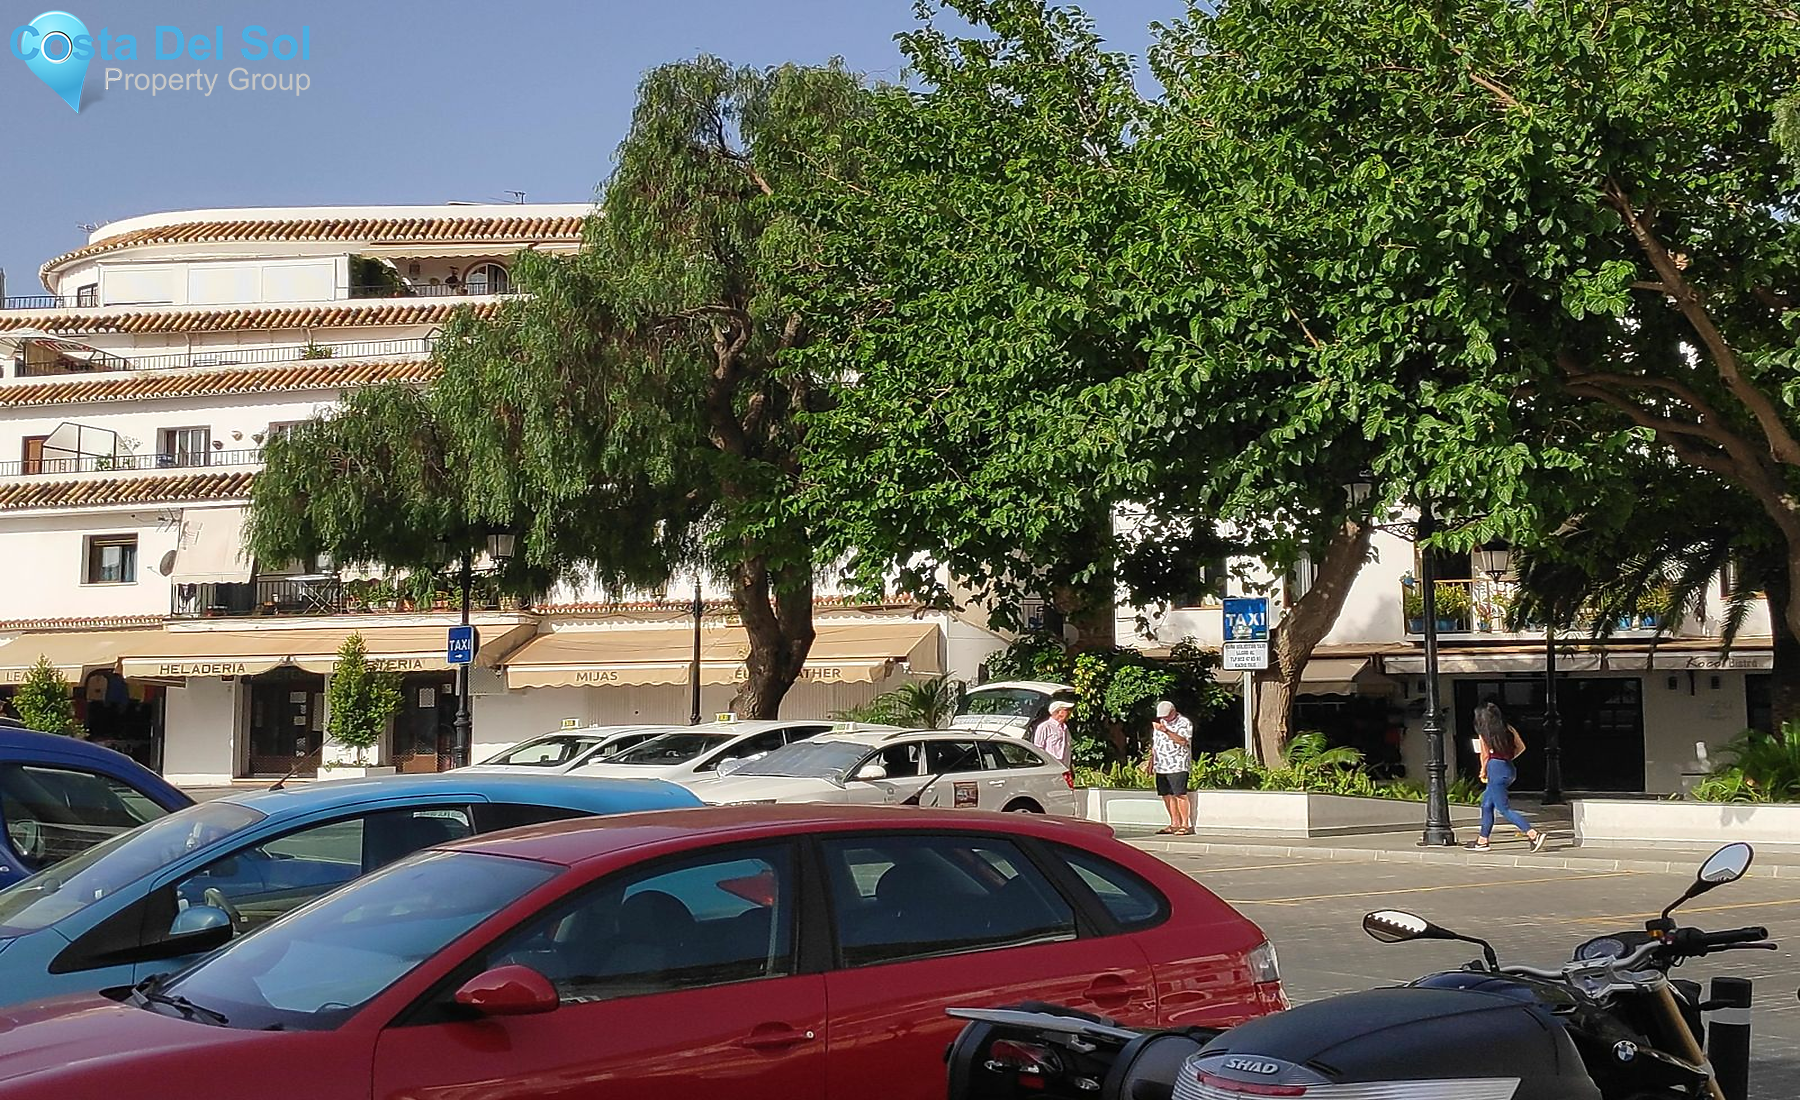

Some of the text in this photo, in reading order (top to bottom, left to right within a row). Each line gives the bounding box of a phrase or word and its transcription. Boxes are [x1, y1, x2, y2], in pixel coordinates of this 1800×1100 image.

[1225, 612, 1266, 627] TAXI
[449, 638, 471, 651] TAXI
[160, 663, 246, 675] HELADERIA
[576, 671, 618, 682] MIJAS
[1225, 1058, 1279, 1075] SHAD
